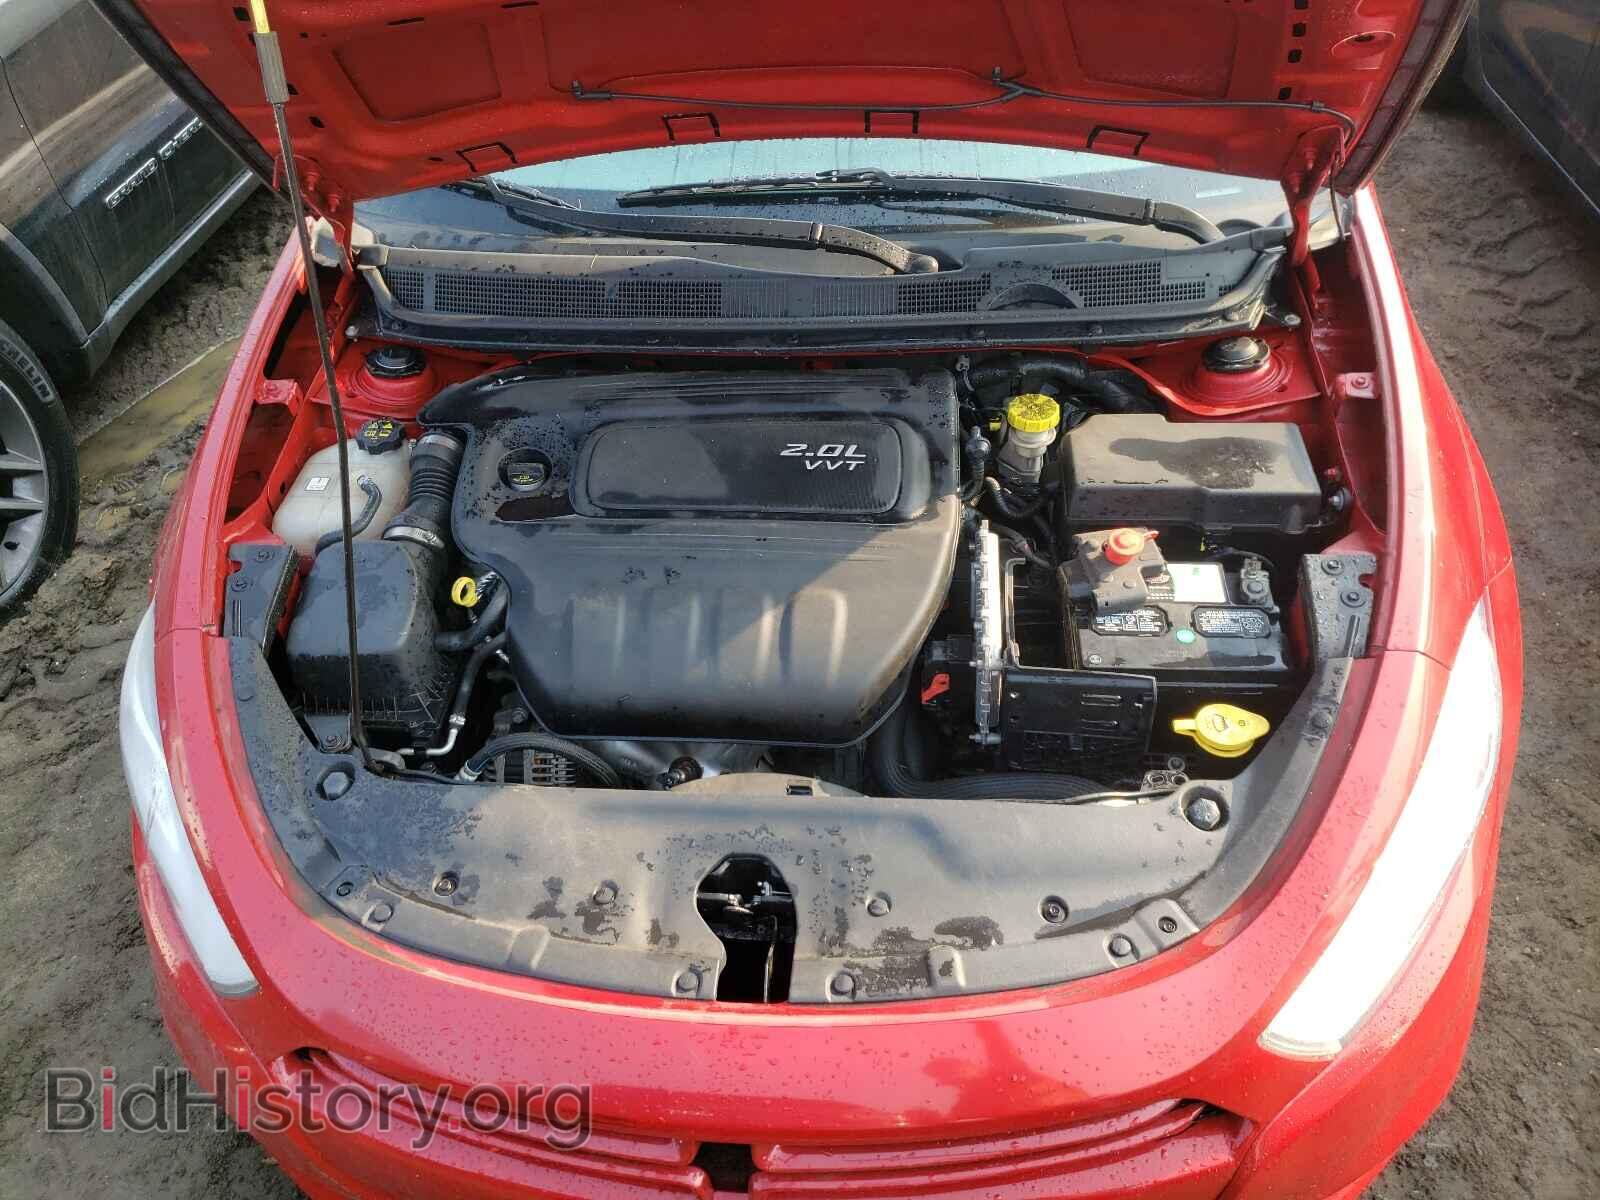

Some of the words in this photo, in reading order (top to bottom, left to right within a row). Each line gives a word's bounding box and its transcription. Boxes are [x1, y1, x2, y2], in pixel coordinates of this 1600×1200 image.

[105, 157, 158, 209] GRAND
[780, 443, 866, 457] 2.0L
[805, 459, 865, 471] VVT
